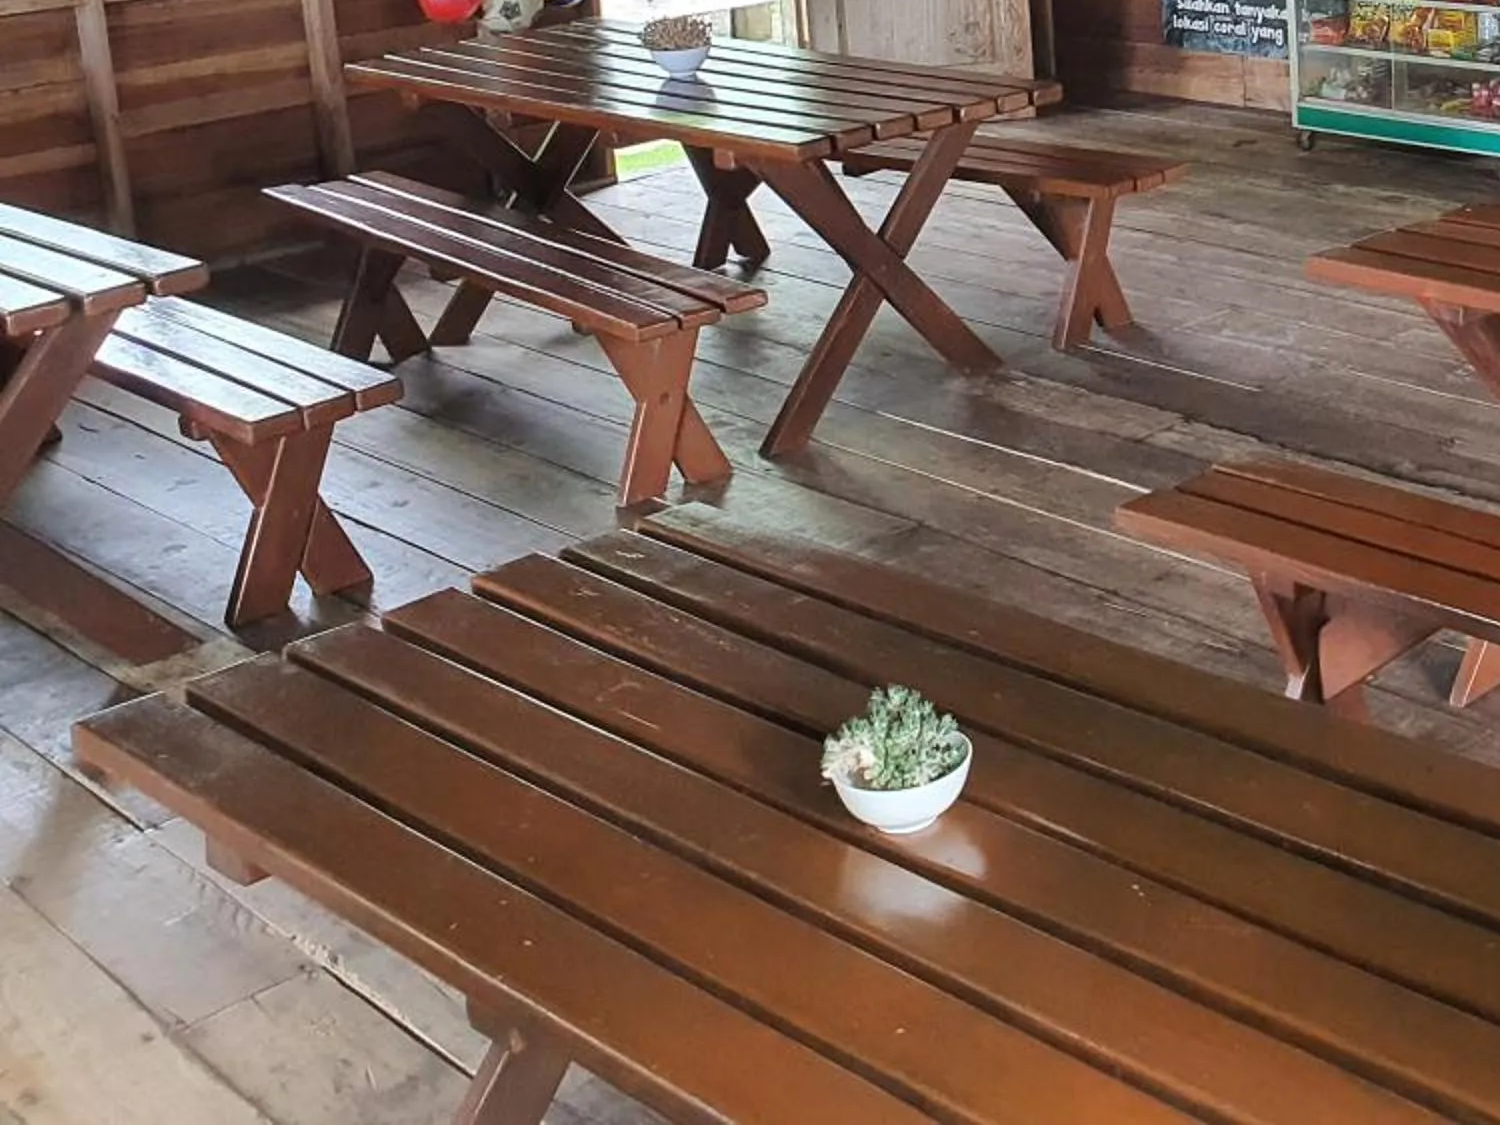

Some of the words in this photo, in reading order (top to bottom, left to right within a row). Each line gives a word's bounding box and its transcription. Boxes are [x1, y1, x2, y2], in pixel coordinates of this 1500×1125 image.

[1234, 0, 1290, 24] tanyaka
[1173, 15, 1209, 32] lokasi
[1214, 22, 1246, 36] coral
[1251, 25, 1284, 45] yang
